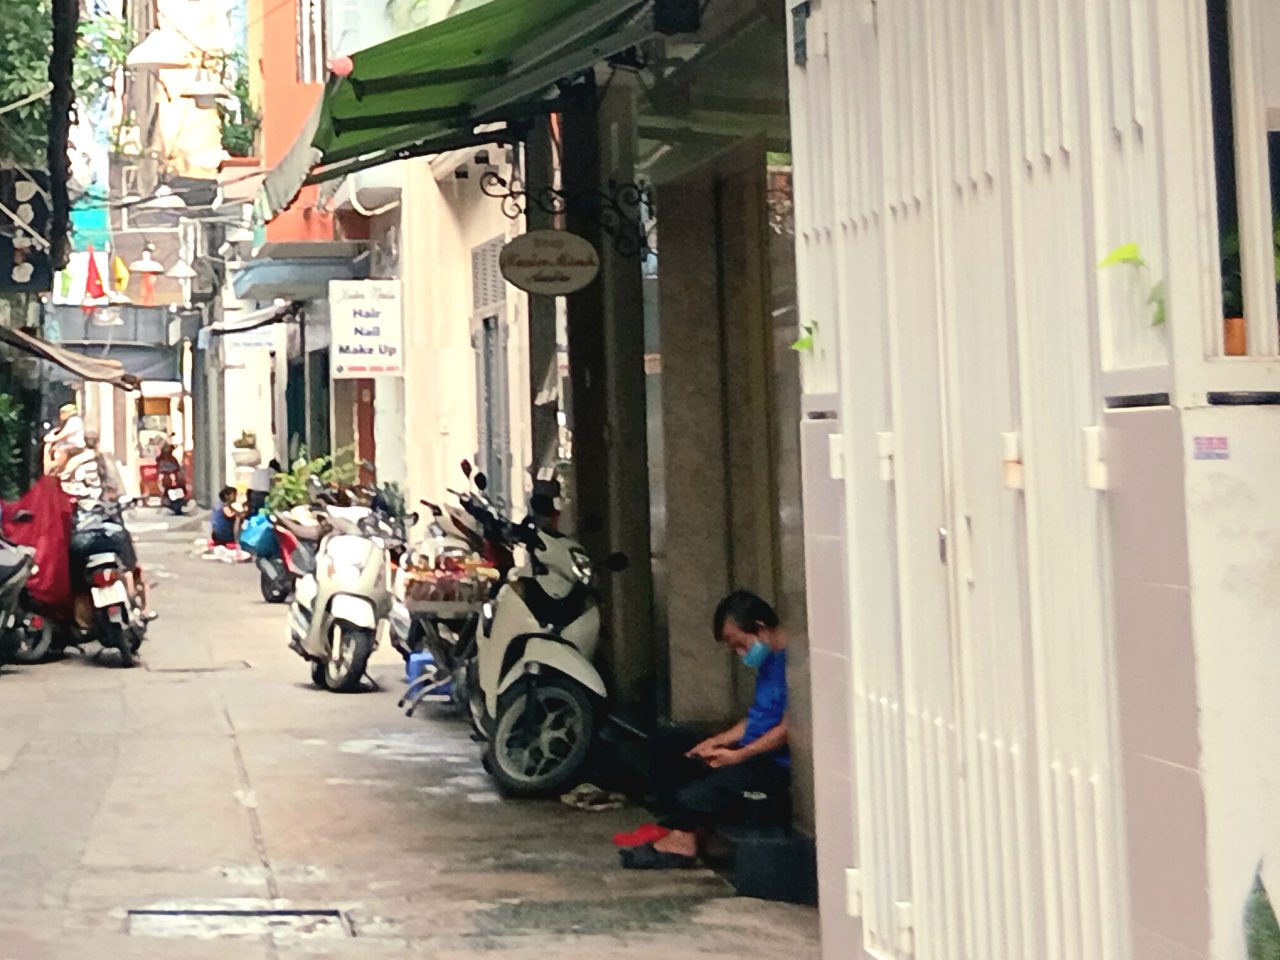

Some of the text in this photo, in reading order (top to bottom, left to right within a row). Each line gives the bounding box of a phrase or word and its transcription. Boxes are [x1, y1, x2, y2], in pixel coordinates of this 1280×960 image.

[352, 308, 382, 318] Hair
[354, 326, 381, 336] Nail
[338, 344, 397, 357] Make Up
